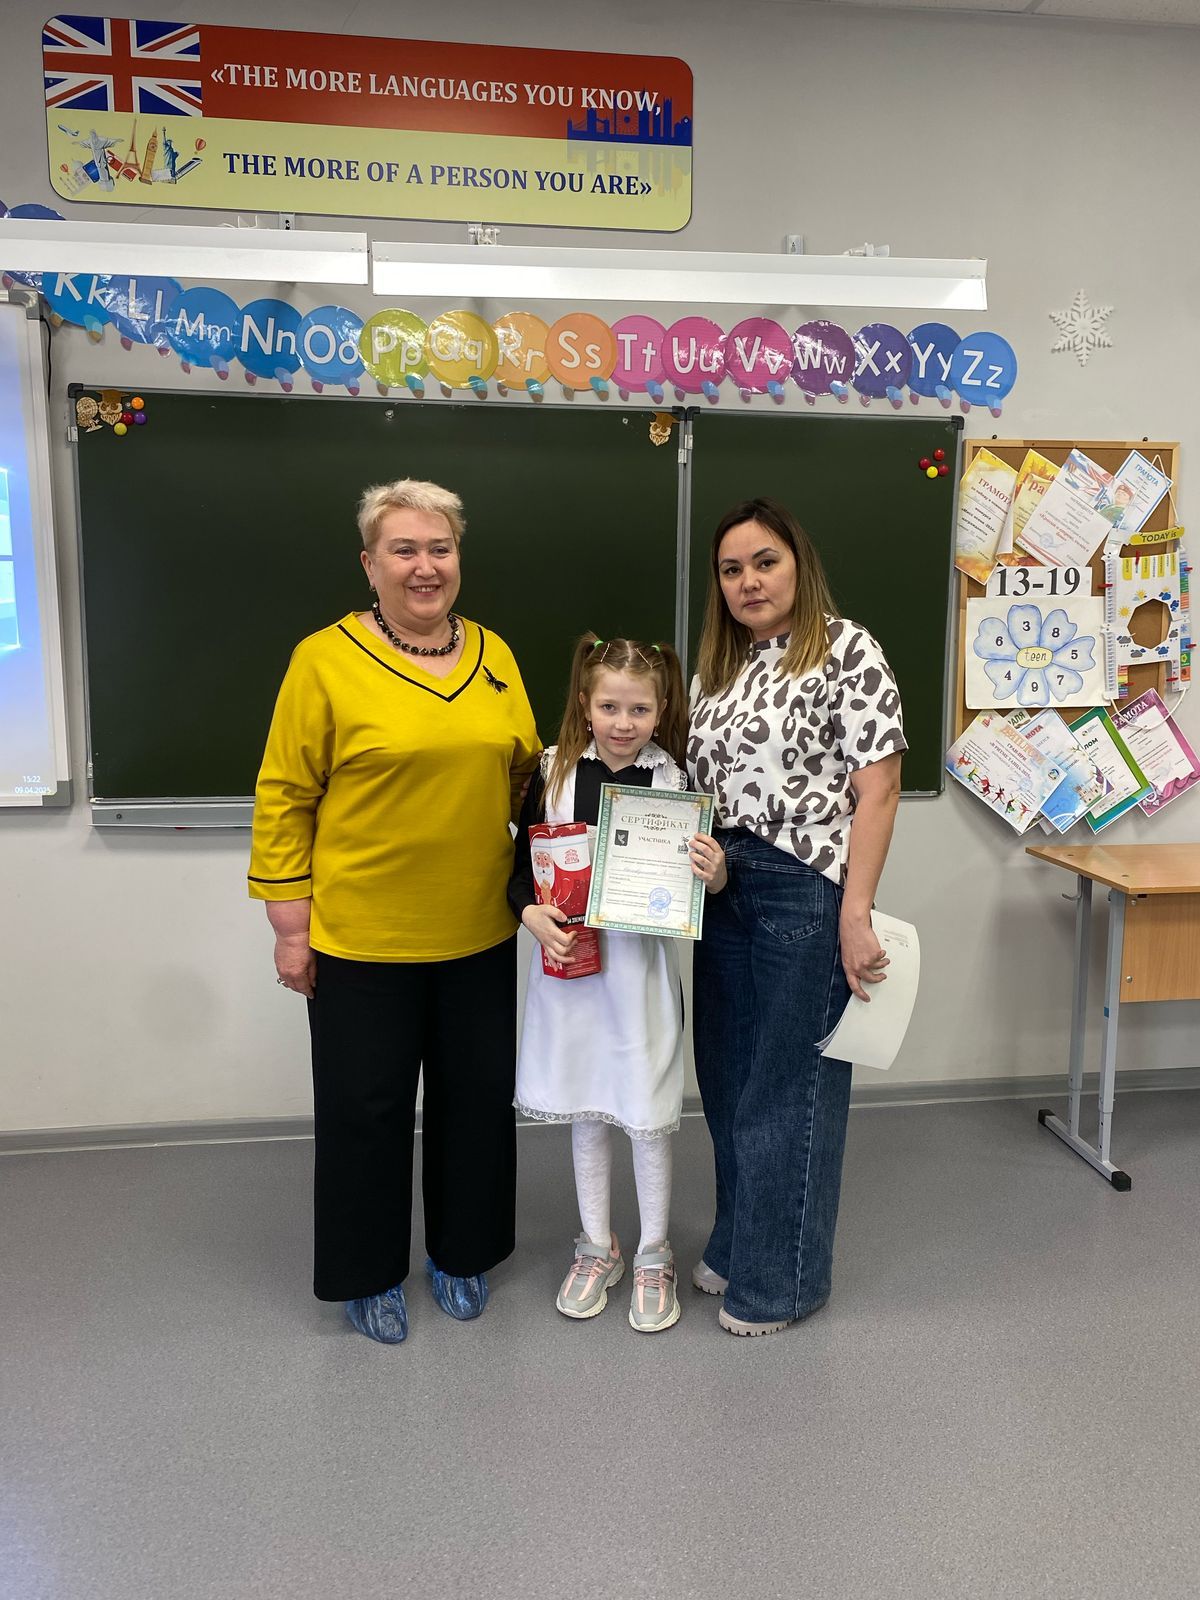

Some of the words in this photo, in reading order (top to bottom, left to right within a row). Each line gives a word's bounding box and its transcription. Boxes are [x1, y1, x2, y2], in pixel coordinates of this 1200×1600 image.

[211, 63, 278, 88] «THE
[285, 67, 362, 94] MORE
[369, 73, 517, 103] LANGUAGES
[523, 84, 573, 107] YOU
[581, 88, 661, 116] KNOW,
[222, 152, 277, 176] THE
[284, 156, 360, 181] MORE
[366, 161, 399, 183] OF
[406, 164, 423, 184] A
[430, 165, 527, 190] PERSON
[534, 171, 584, 193] YOU
[590, 174, 652, 195] ARE»
[1141, 532, 1170, 543] TODAY
[995, 567, 1080, 597] 13-19
[1022, 620, 1031, 632] 3
[1051, 627, 1060, 638] 8
[995, 635, 1004, 647] 6
[1024, 647, 1047, 662] teen
[1070, 649, 1078, 660] 5
[1004, 670, 1012, 681] 4
[1056, 675, 1065, 686] 7
[1031, 681, 1038, 692] 9
[22, 775, 41, 783] 15:22
[14, 786, 52, 795] 09.04.2025
[621, 815, 690, 830] СЕРТИФИКАТ
[638, 836, 671, 845] УЧАСТНИКА
